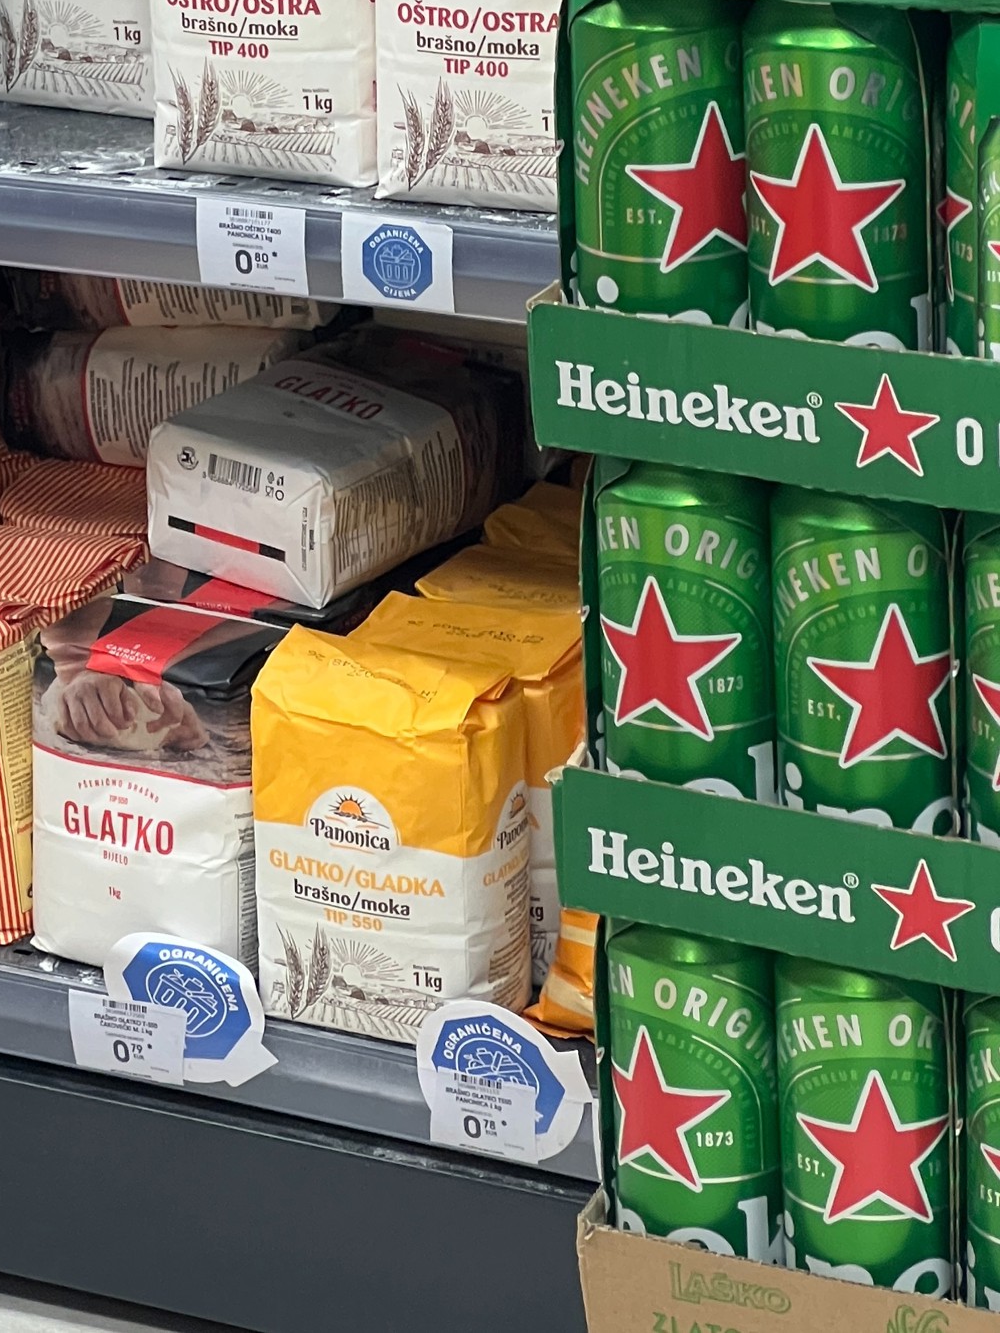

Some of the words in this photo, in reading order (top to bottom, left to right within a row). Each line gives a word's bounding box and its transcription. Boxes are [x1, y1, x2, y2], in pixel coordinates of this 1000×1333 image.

[181, 12, 299, 37] brašno/moka
[397, 3, 561, 33] OŠTRO/OSTRA
[208, 40, 234, 56] TIP
[238, 42, 269, 58] 400
[416, 32, 540, 58] brašno/moka
[443, 58, 470, 75] TIP
[474, 60, 509, 78] 400
[574, 45, 701, 185] HEINEKEN
[626, 207, 662, 225] EST.
[369, 228, 424, 254] OGRANIČENA
[235, 249, 252, 274] 0
[255, 251, 269, 263] 80
[383, 286, 417, 297] CIJENA
[275, 376, 384, 420] GLATKO
[555, 360, 821, 444] Heineken
[707, 675, 744, 694] 1873
[807, 699, 842, 721] EST.
[64, 800, 174, 855] GLATKO
[310, 817, 391, 852] Panonica
[103, 850, 129, 866] BIJELO
[269, 849, 445, 898] GLATKO/GLADKA
[587, 827, 855, 923] Heineken
[293, 879, 410, 916] brašno/moka
[323, 909, 348, 924] TIP
[352, 914, 383, 932] 550
[158, 948, 239, 1013] OGRANIČENA
[113, 1040, 130, 1063] 0
[131, 1043, 143, 1054] 79
[442, 1023, 522, 1060] OGRANIČENA
[463, 1115, 481, 1139] 0
[484, 1118, 495, 1130] 78
[696, 1131, 734, 1147] 1873
[668, 1260, 791, 1314] LAŠKO
